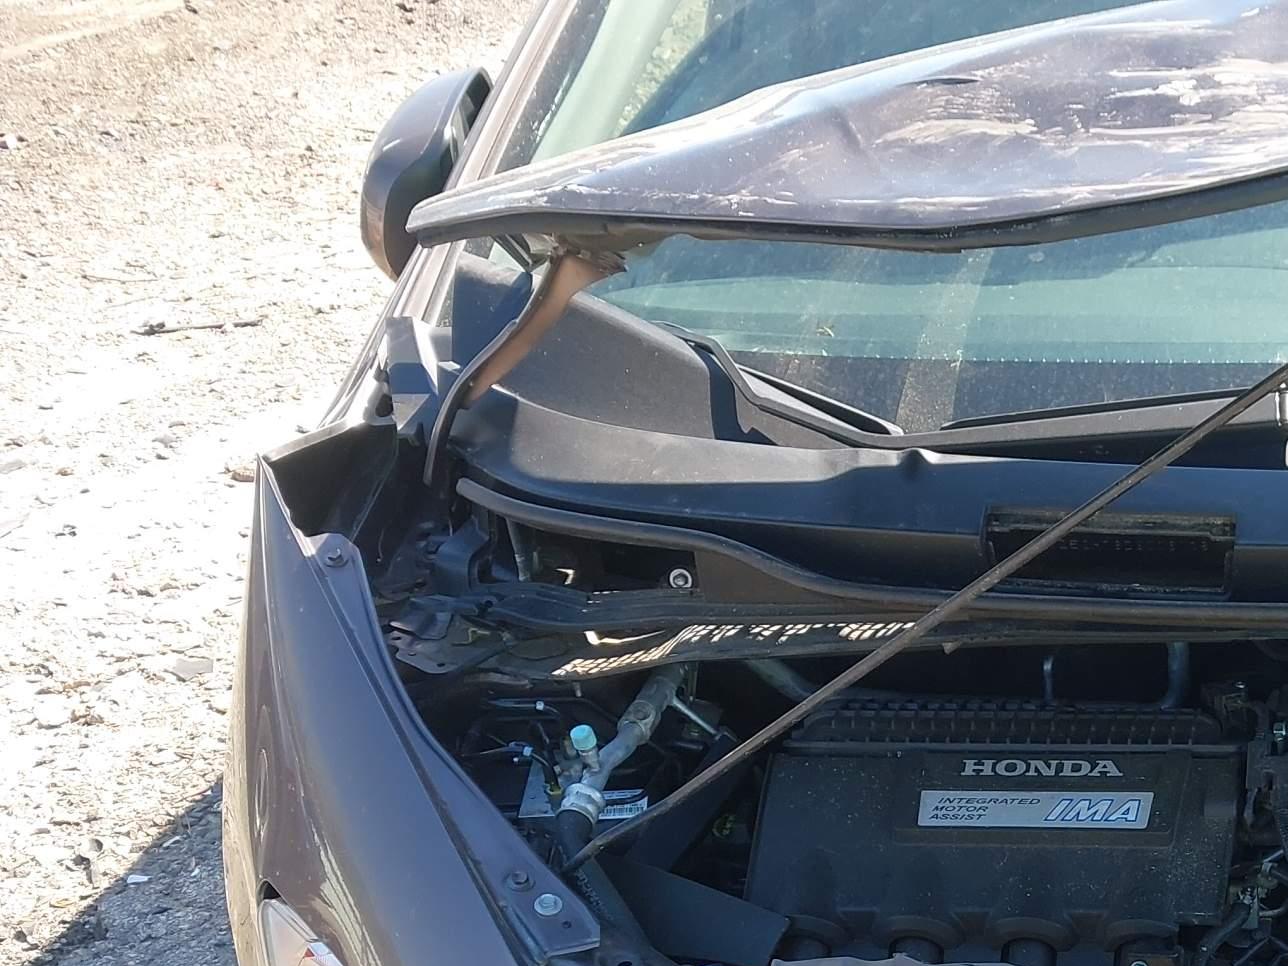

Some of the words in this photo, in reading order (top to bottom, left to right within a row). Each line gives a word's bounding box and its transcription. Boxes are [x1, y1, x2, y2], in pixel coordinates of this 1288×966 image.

[960, 759, 1123, 777] HONDA
[938, 797, 1041, 805] INTEGRATED
[932, 805, 989, 813] MOTOR
[1043, 798, 1143, 822] IMA
[929, 813, 987, 821] ASSIST
